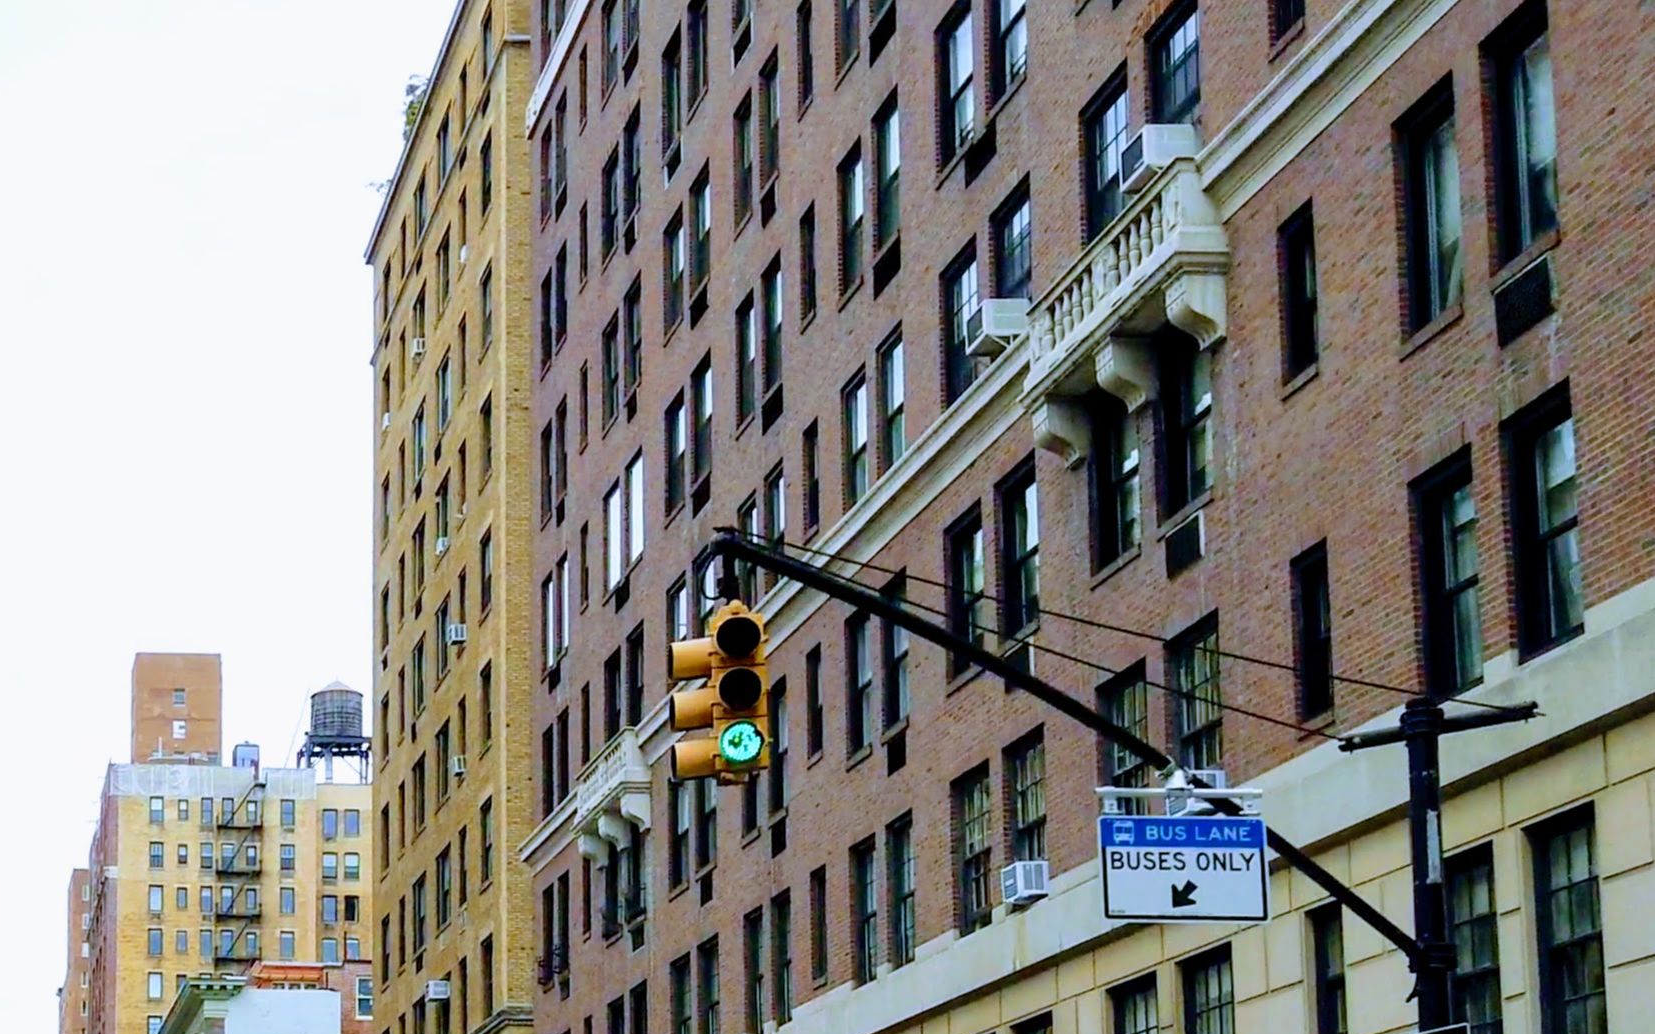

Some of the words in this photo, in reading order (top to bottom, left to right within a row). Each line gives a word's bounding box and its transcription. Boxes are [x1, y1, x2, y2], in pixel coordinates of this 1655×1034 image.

[1145, 825, 1187, 841] BUS
[1195, 826, 1252, 842] LANE
[1111, 851, 1186, 870] BUSES
[1196, 851, 1255, 871] ONLY
